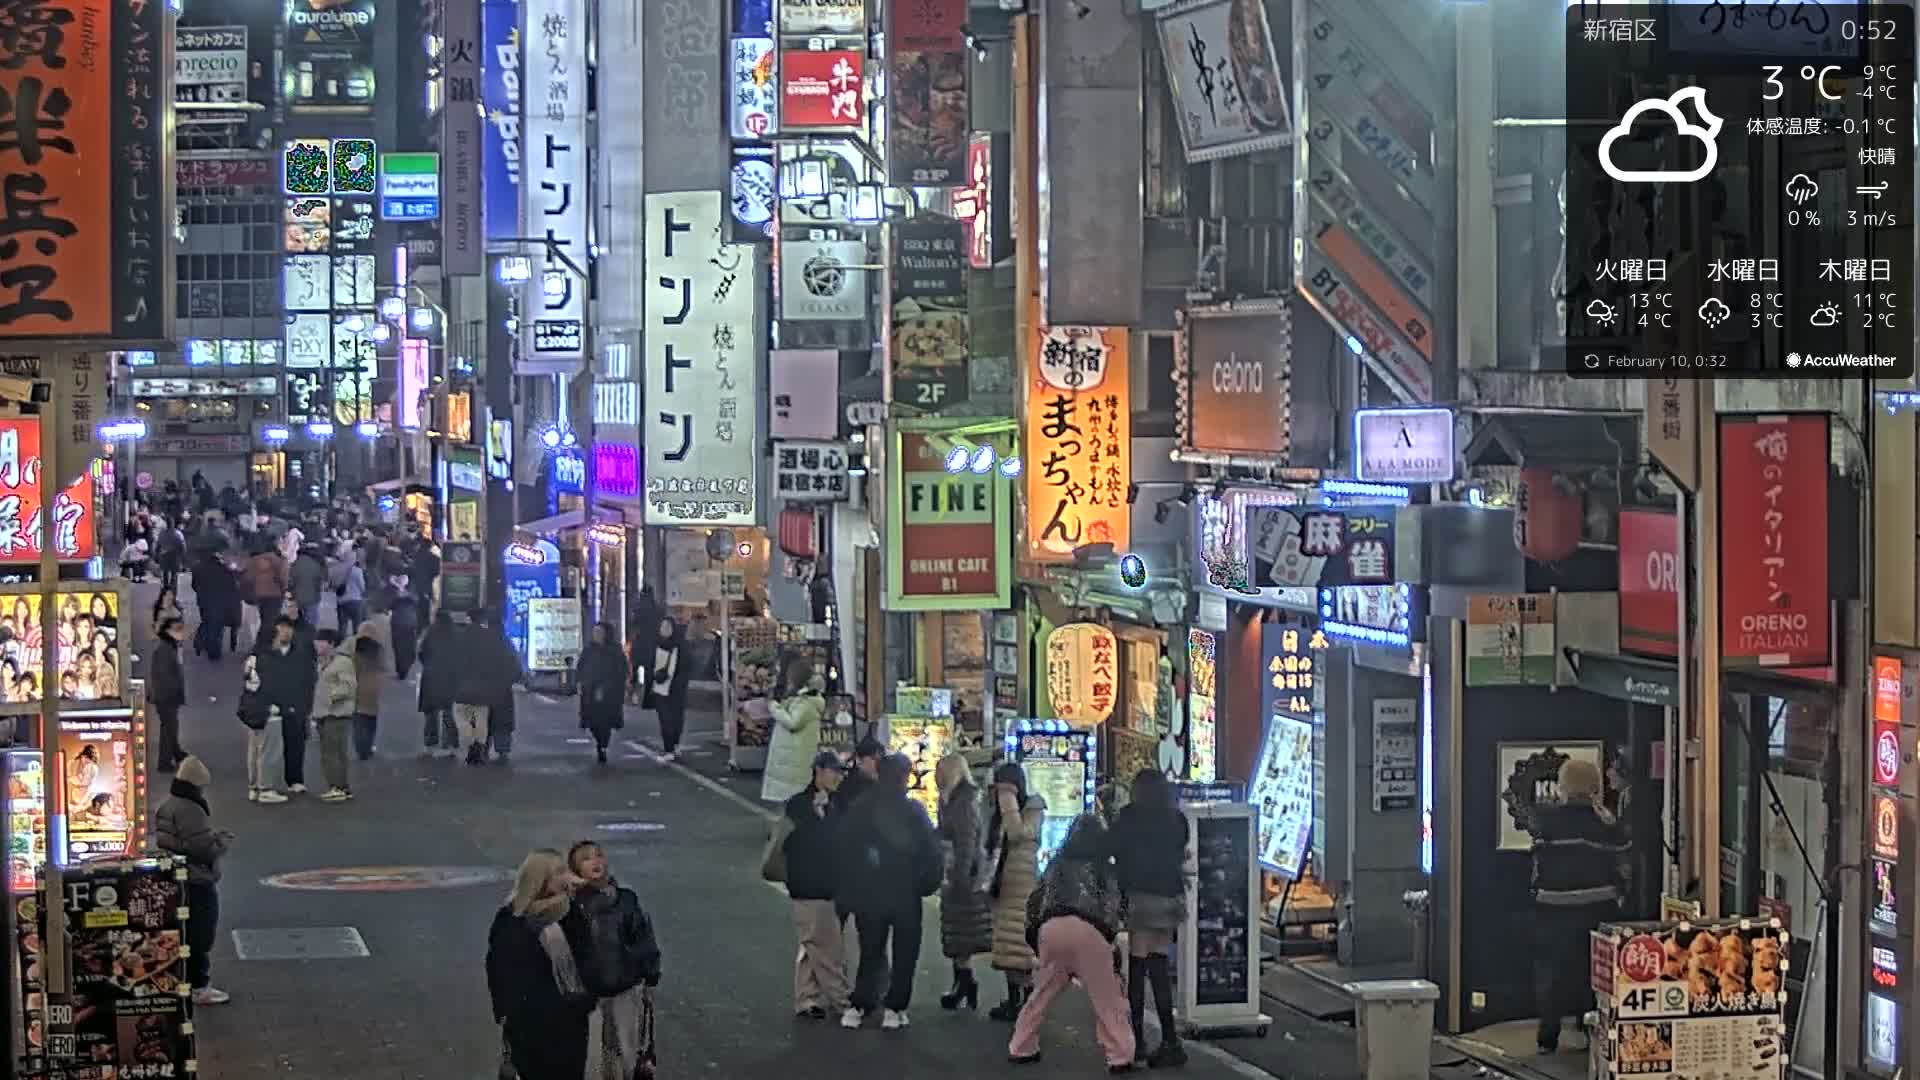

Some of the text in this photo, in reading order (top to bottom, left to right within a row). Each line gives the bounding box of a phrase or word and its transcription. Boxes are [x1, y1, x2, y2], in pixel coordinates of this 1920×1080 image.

[294, 9, 369, 25] auralume
[1313, 20, 1333, 40] 5
[829, 57, 860, 121] 牛門
[1313, 73, 1333, 90] 4
[1313, 120, 1334, 140] 3
[386, 179, 436, 194] FamilyMart
[1312, 170, 1333, 191] 2
[540, 133, 571, 310] トントン
[901, 252, 961, 271] Walton's
[1311, 267, 1340, 297] B1
[659, 207, 691, 461] トントン
[1045, 340, 1103, 387] 新宿の
[1212, 352, 1263, 393] celona
[712, 324, 738, 441] 焼とん酒場
[917, 383, 946, 402] 2F
[72, 351, 92, 445] 通り一番街
[1393, 420, 1413, 449] A
[779, 449, 844, 471] 酒場心
[1041, 394, 1085, 544] まっちゃん
[778, 473, 844, 493] 新宿本店
[910, 482, 987, 513] FINE
[1349, 518, 1389, 533] フリー
[1754, 429, 1788, 602] 俺のイタリアン
[910, 558, 989, 573] ONLINE CAFE
[1741, 613, 1808, 631] ORENO
[1739, 632, 1808, 649] ITALIAN
[1622, 988, 1657, 1012] 4F
[1691, 991, 1778, 1015] 炭火焼き鳥
